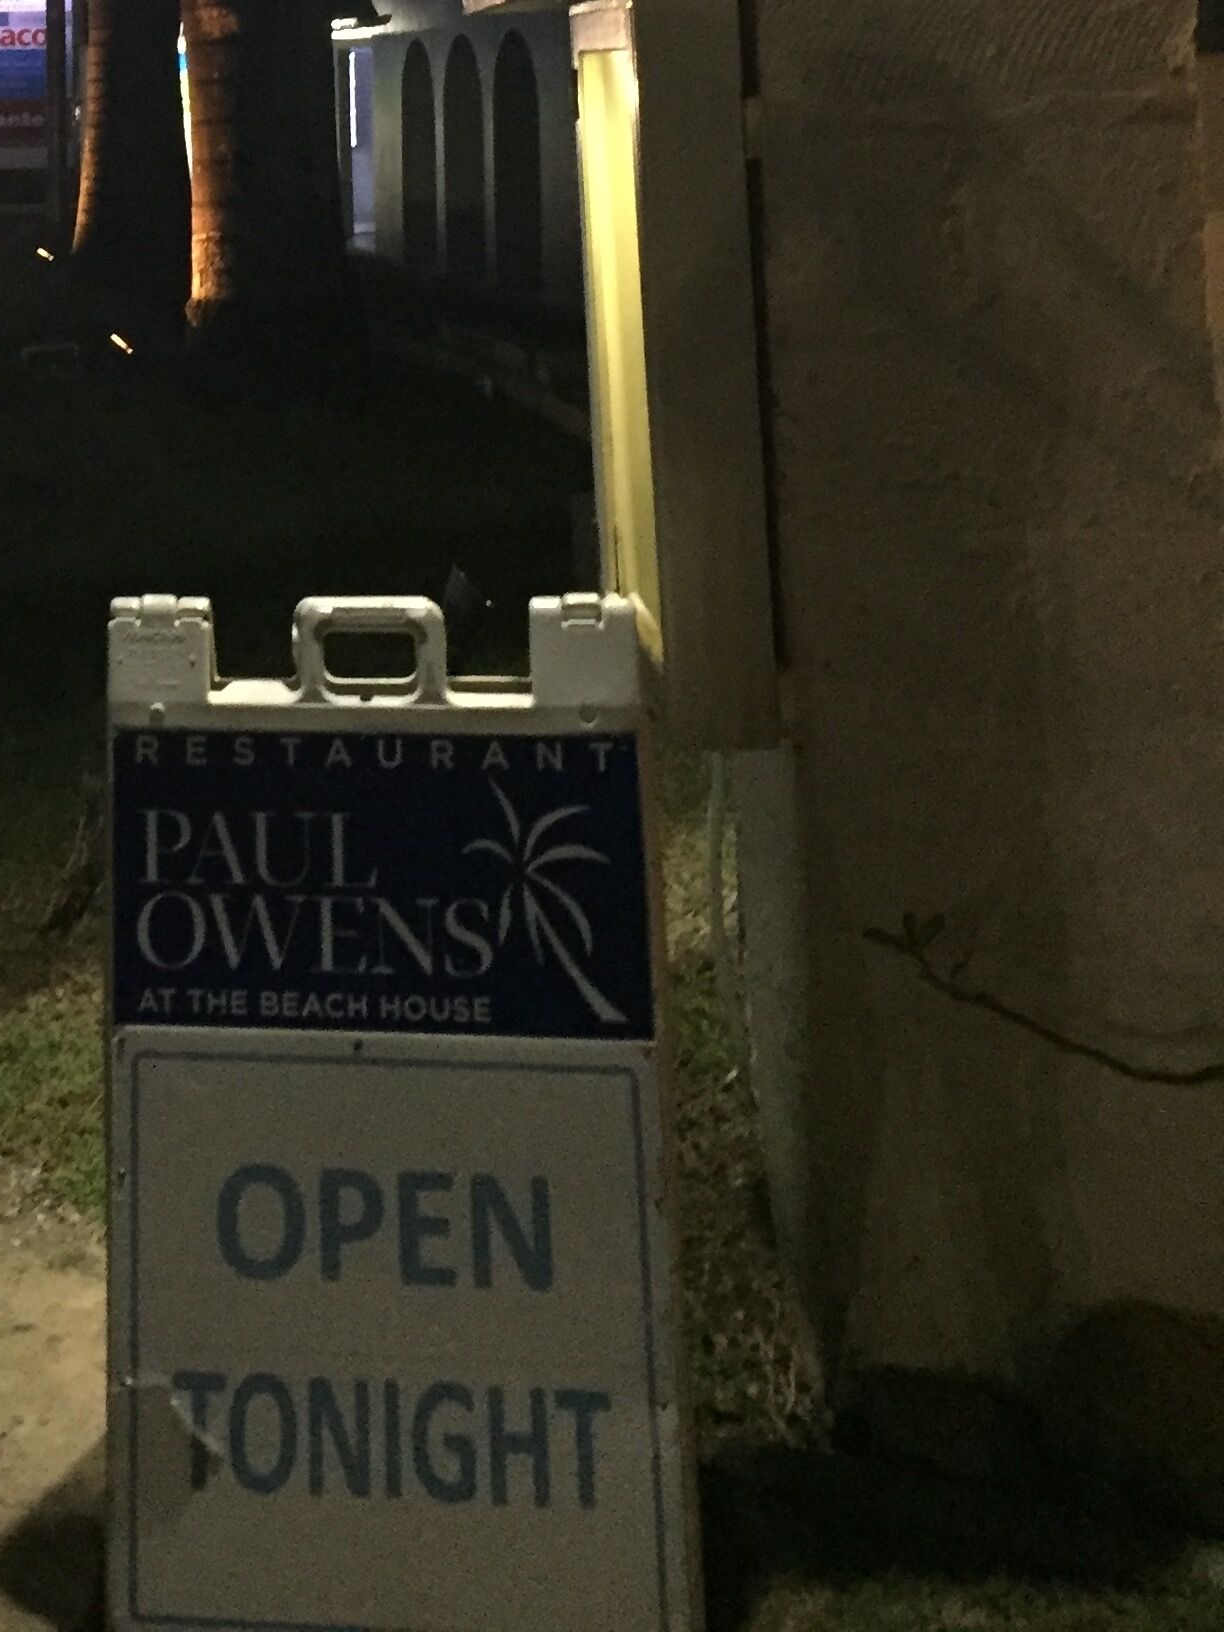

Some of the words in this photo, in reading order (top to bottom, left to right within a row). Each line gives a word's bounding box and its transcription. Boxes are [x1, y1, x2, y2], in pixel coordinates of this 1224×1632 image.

[135, 735, 613, 773] RESTAURANT
[138, 808, 377, 887] PAUL
[136, 891, 494, 979] OWENS
[139, 988, 175, 1013] AT
[188, 988, 248, 1016] THE
[260, 991, 369, 1020] BEACH
[379, 995, 492, 1023] HOUSE
[216, 1163, 554, 1292] OPEN
[172, 1370, 612, 1511] TONIGHT
